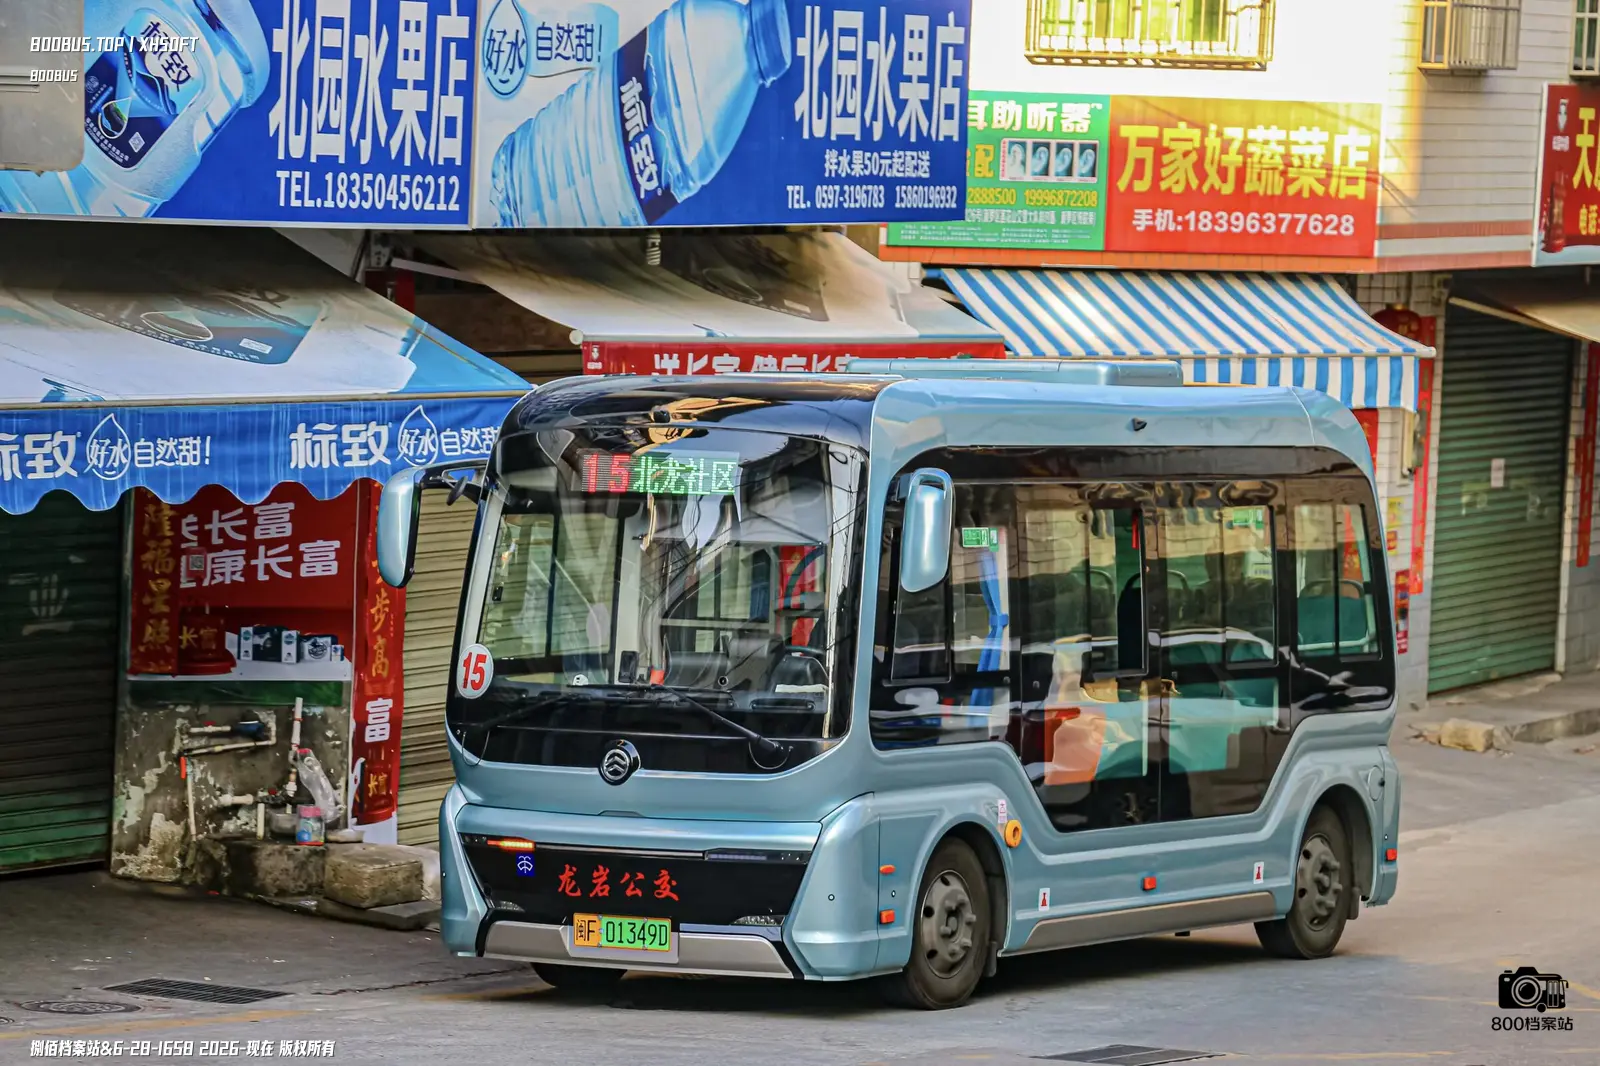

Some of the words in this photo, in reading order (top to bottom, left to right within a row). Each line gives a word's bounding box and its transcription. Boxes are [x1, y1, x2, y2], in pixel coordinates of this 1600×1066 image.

[484, 29, 526, 75] 好水
[269, 0, 470, 166] 北园水果店
[794, 6, 966, 142] 北园水果店
[966, 144, 994, 178] 配
[1117, 122, 1371, 199] 万家好蔬菜店
[1572, 107, 1600, 190] 天
[276, 170, 460, 211] TEL.18350456212
[786, 185, 811, 209] TEL.
[815, 185, 885, 209] 0597-3196783
[895, 186, 957, 209] 15860196932
[1132, 208, 1355, 236] 手机:18396377628
[88, 439, 129, 469] 好水
[134, 436, 211, 468] 自然甜!
[289, 421, 392, 469] 标致
[400, 428, 436, 457] 好水
[583, 454, 631, 493] 15
[633, 457, 737, 495] 北龙社区
[368, 560, 391, 680] 步高
[462, 652, 488, 691] 15
[364, 697, 393, 743] 富
[557, 863, 680, 902] 龙岩公交
[605, 921, 668, 946] 01349D
